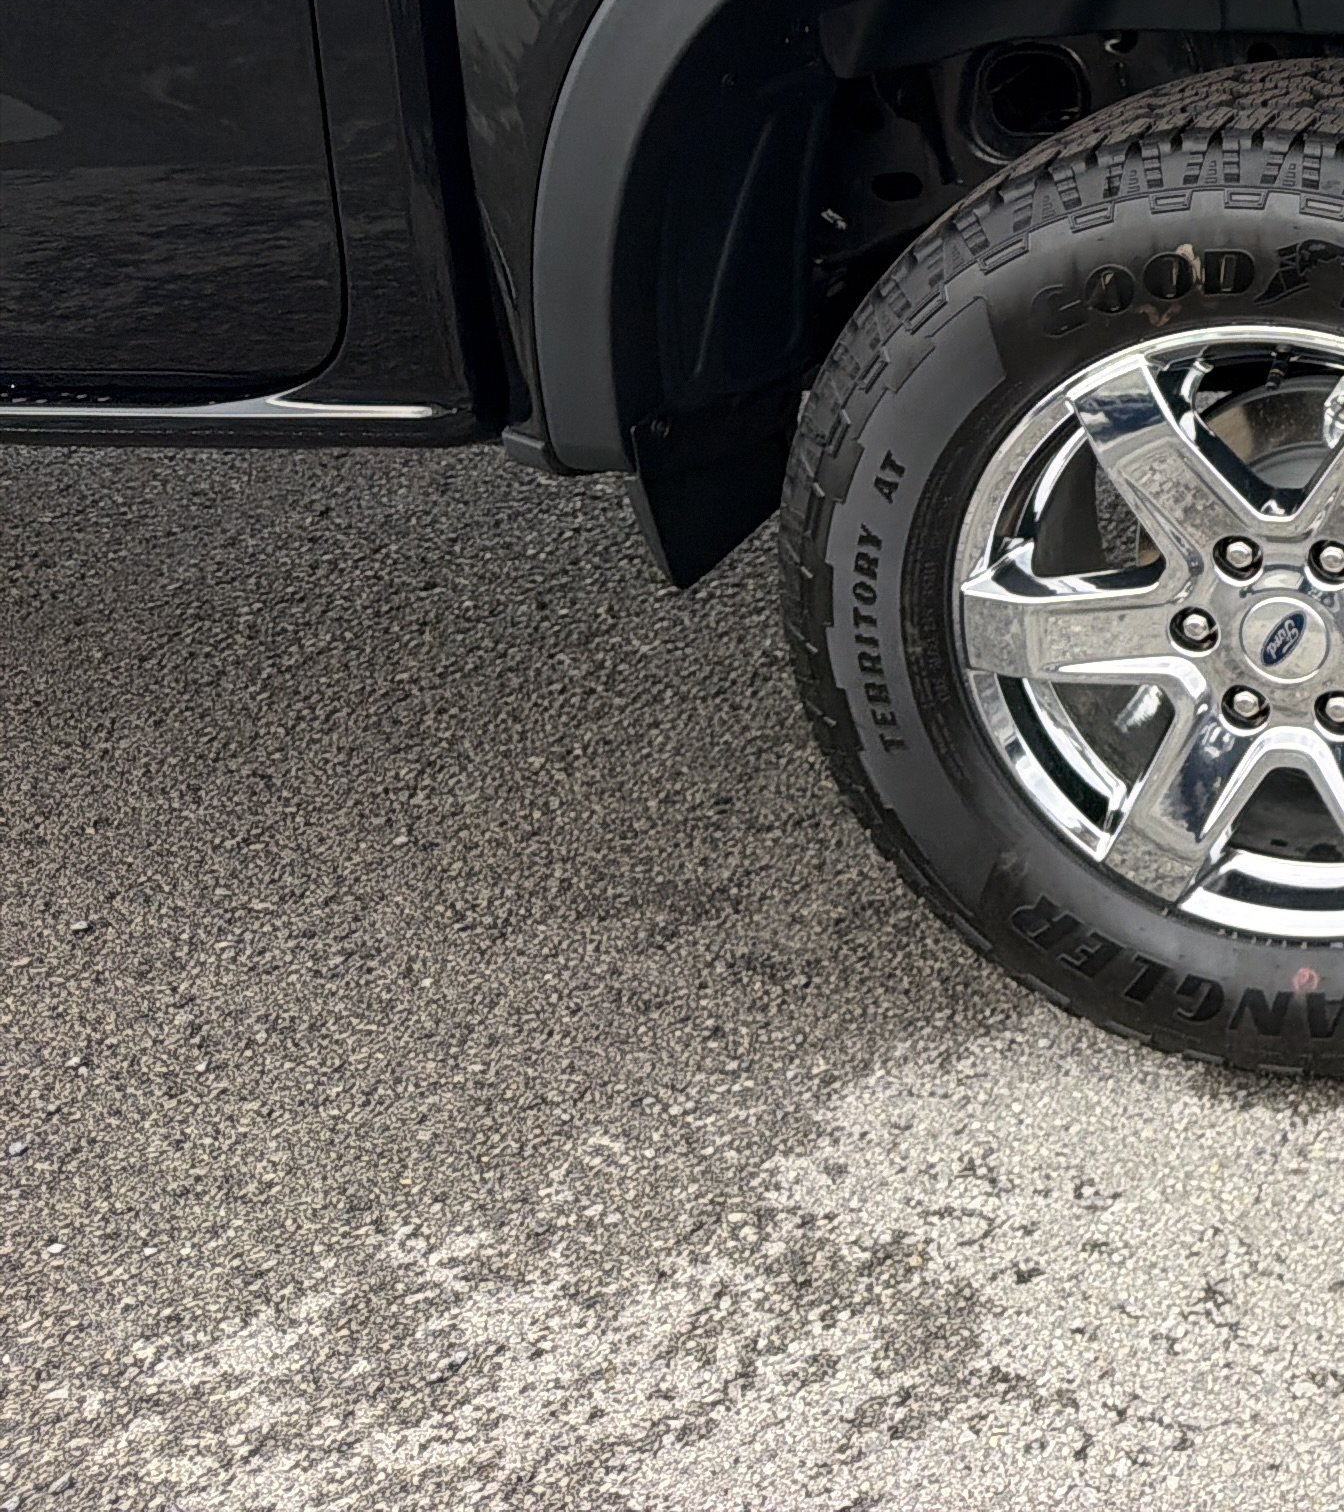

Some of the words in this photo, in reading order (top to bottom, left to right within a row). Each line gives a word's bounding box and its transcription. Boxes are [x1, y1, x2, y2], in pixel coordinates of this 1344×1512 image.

[873, 449, 907, 505] AT
[852, 522, 907, 754] TERRITORY
[1265, 619, 1300, 660] Ford
